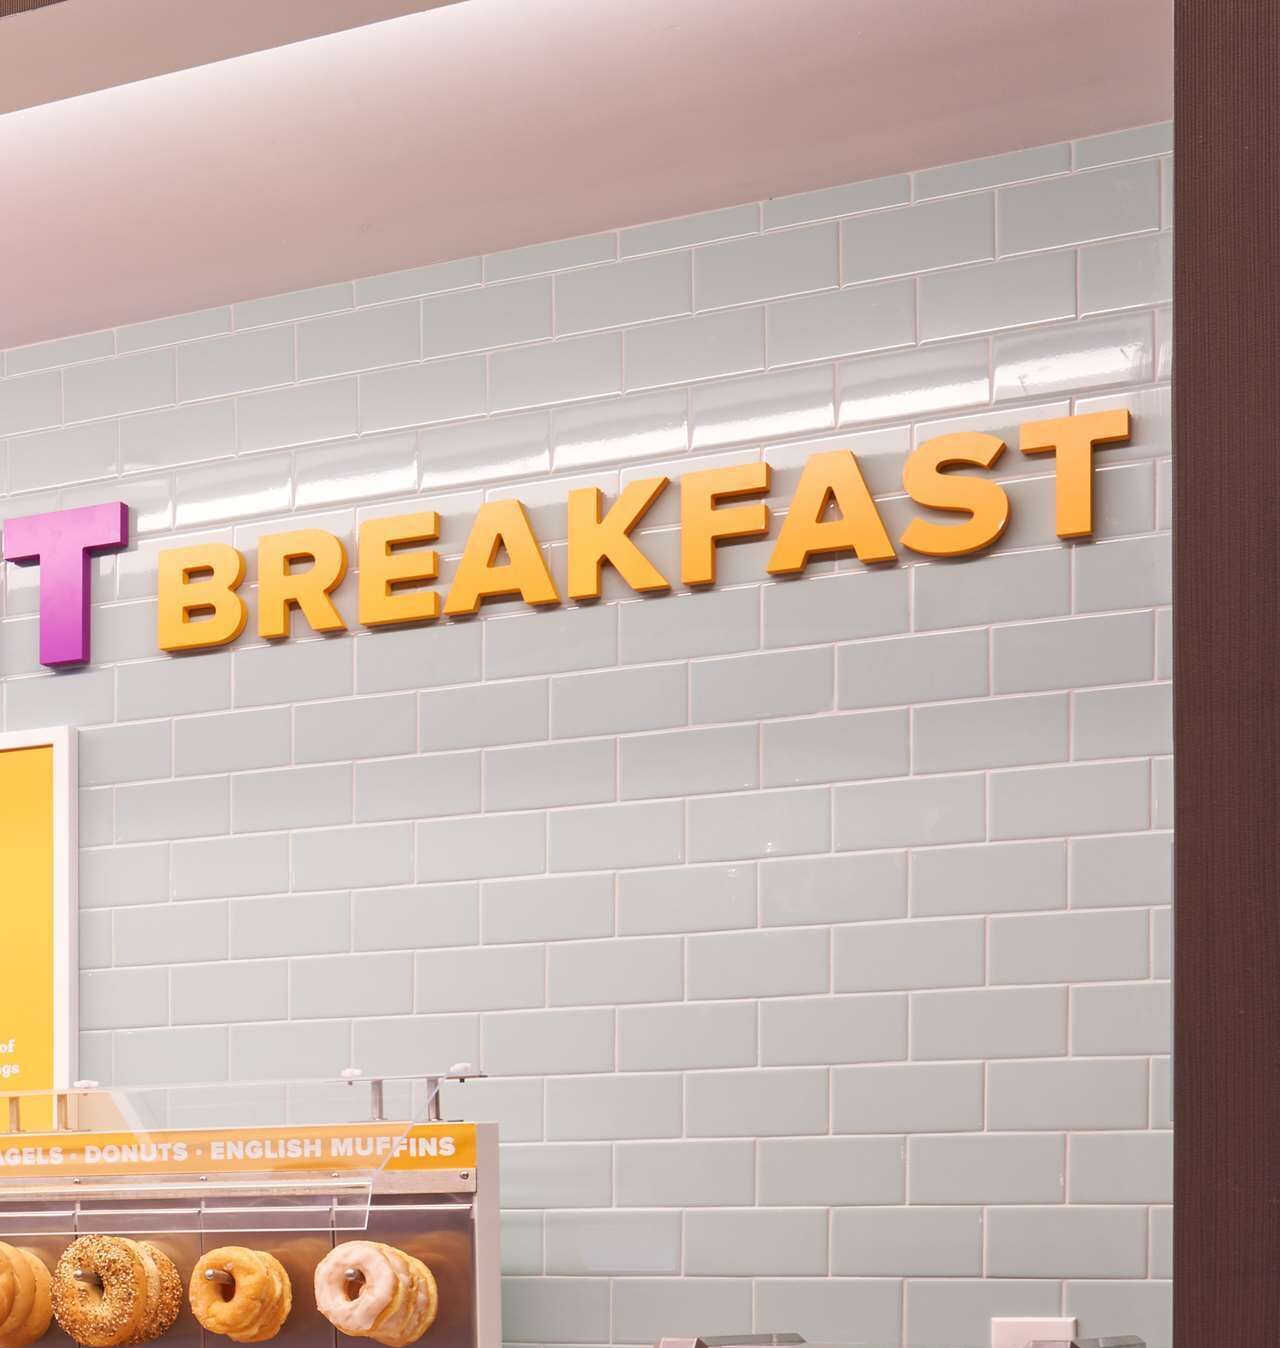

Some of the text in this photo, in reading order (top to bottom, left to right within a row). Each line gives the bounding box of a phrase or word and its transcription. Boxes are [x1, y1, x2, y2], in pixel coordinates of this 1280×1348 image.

[156, 409, 1131, 653] BREAKFAST
[0, 1039, 16, 1053] of
[84, 1142, 188, 1165] DONUTS
[210, 1138, 322, 1161] ENGLISH
[330, 1135, 457, 1158] MUFFINS
